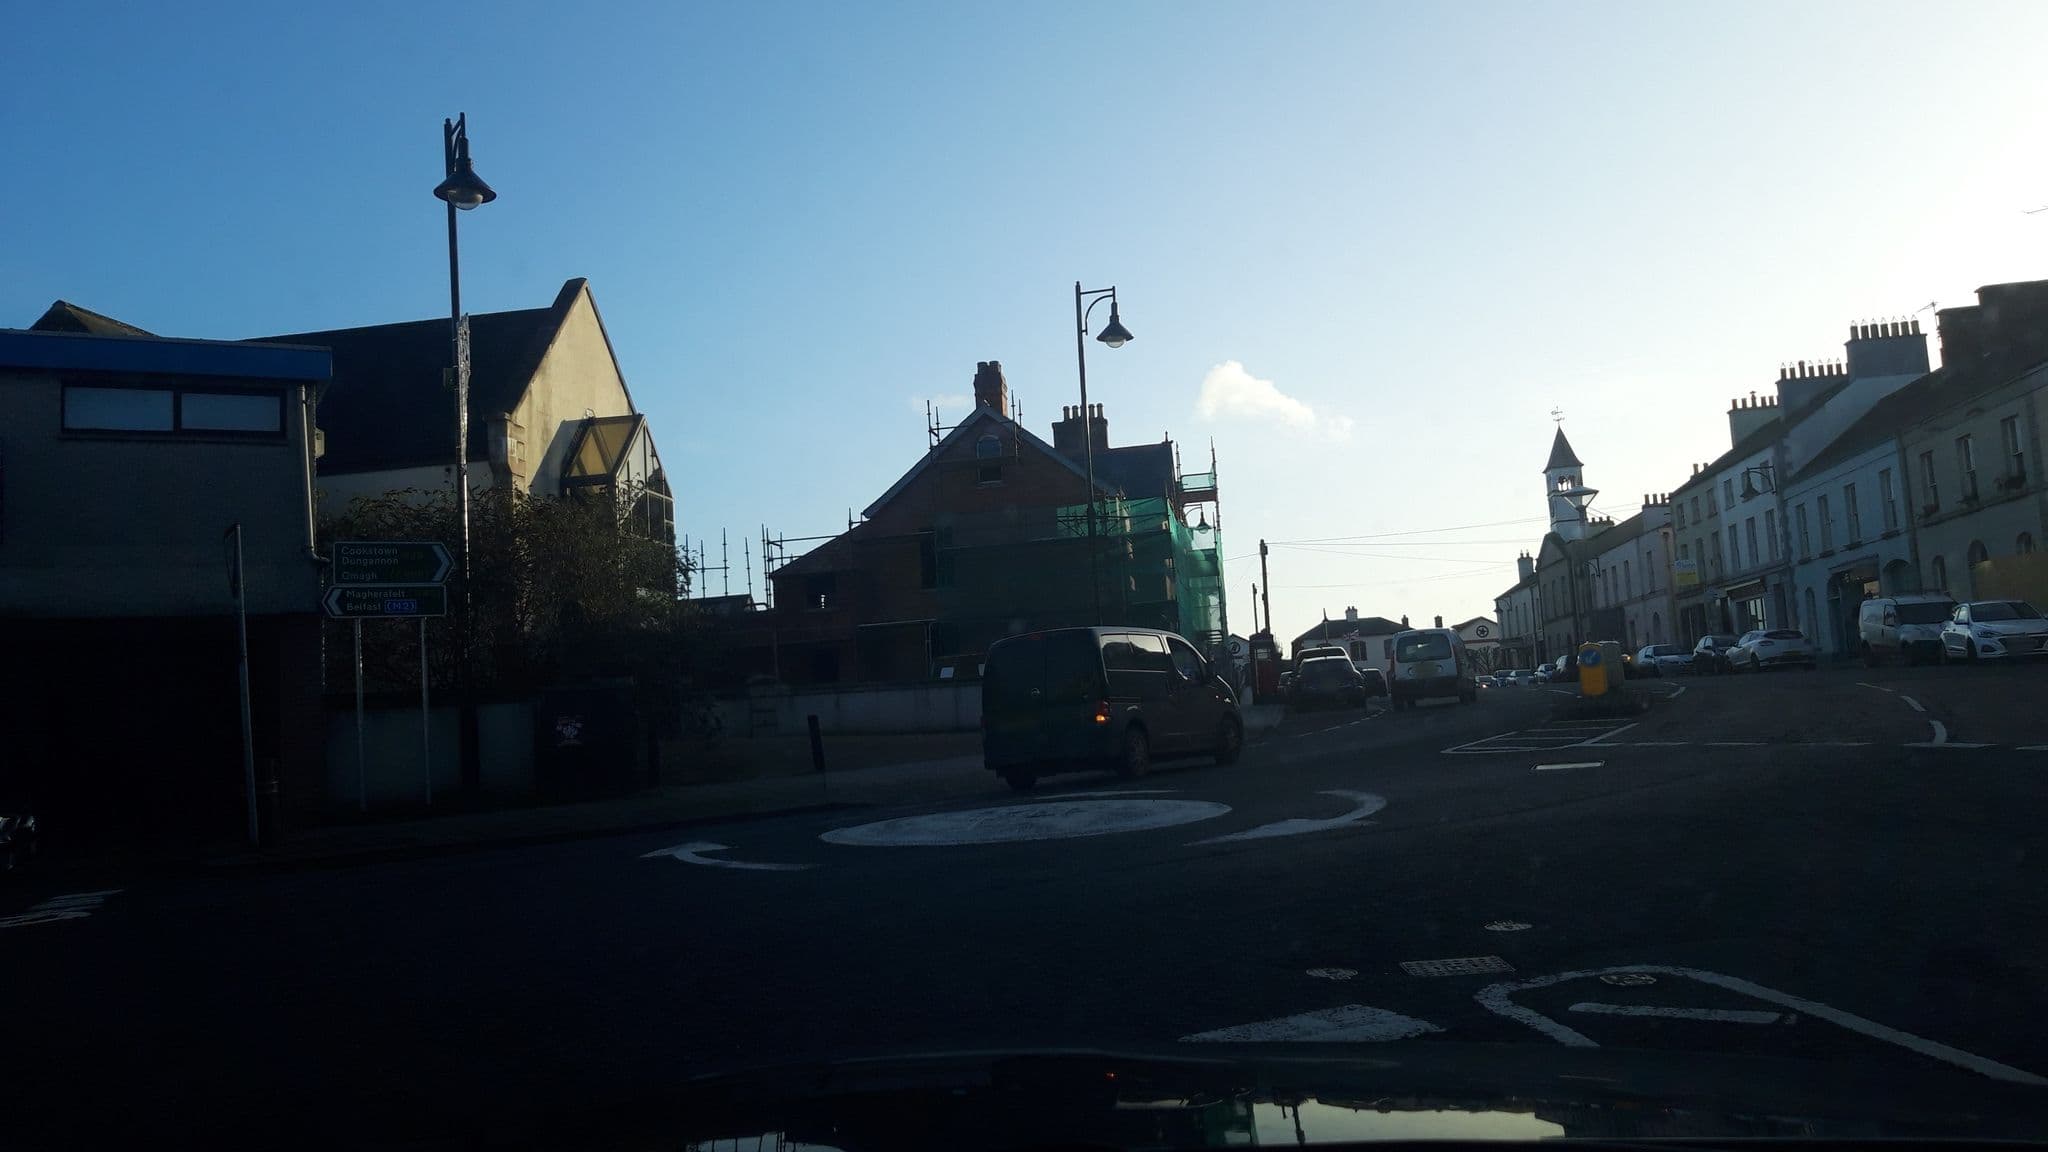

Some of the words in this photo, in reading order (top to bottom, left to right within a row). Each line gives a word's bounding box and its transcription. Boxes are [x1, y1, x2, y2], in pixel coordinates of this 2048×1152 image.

[341, 545, 399, 556] Cookstown
[342, 556, 399, 567] Dungannon
[346, 589, 406, 600] Magherafelt
[346, 602, 382, 612] Belfast
